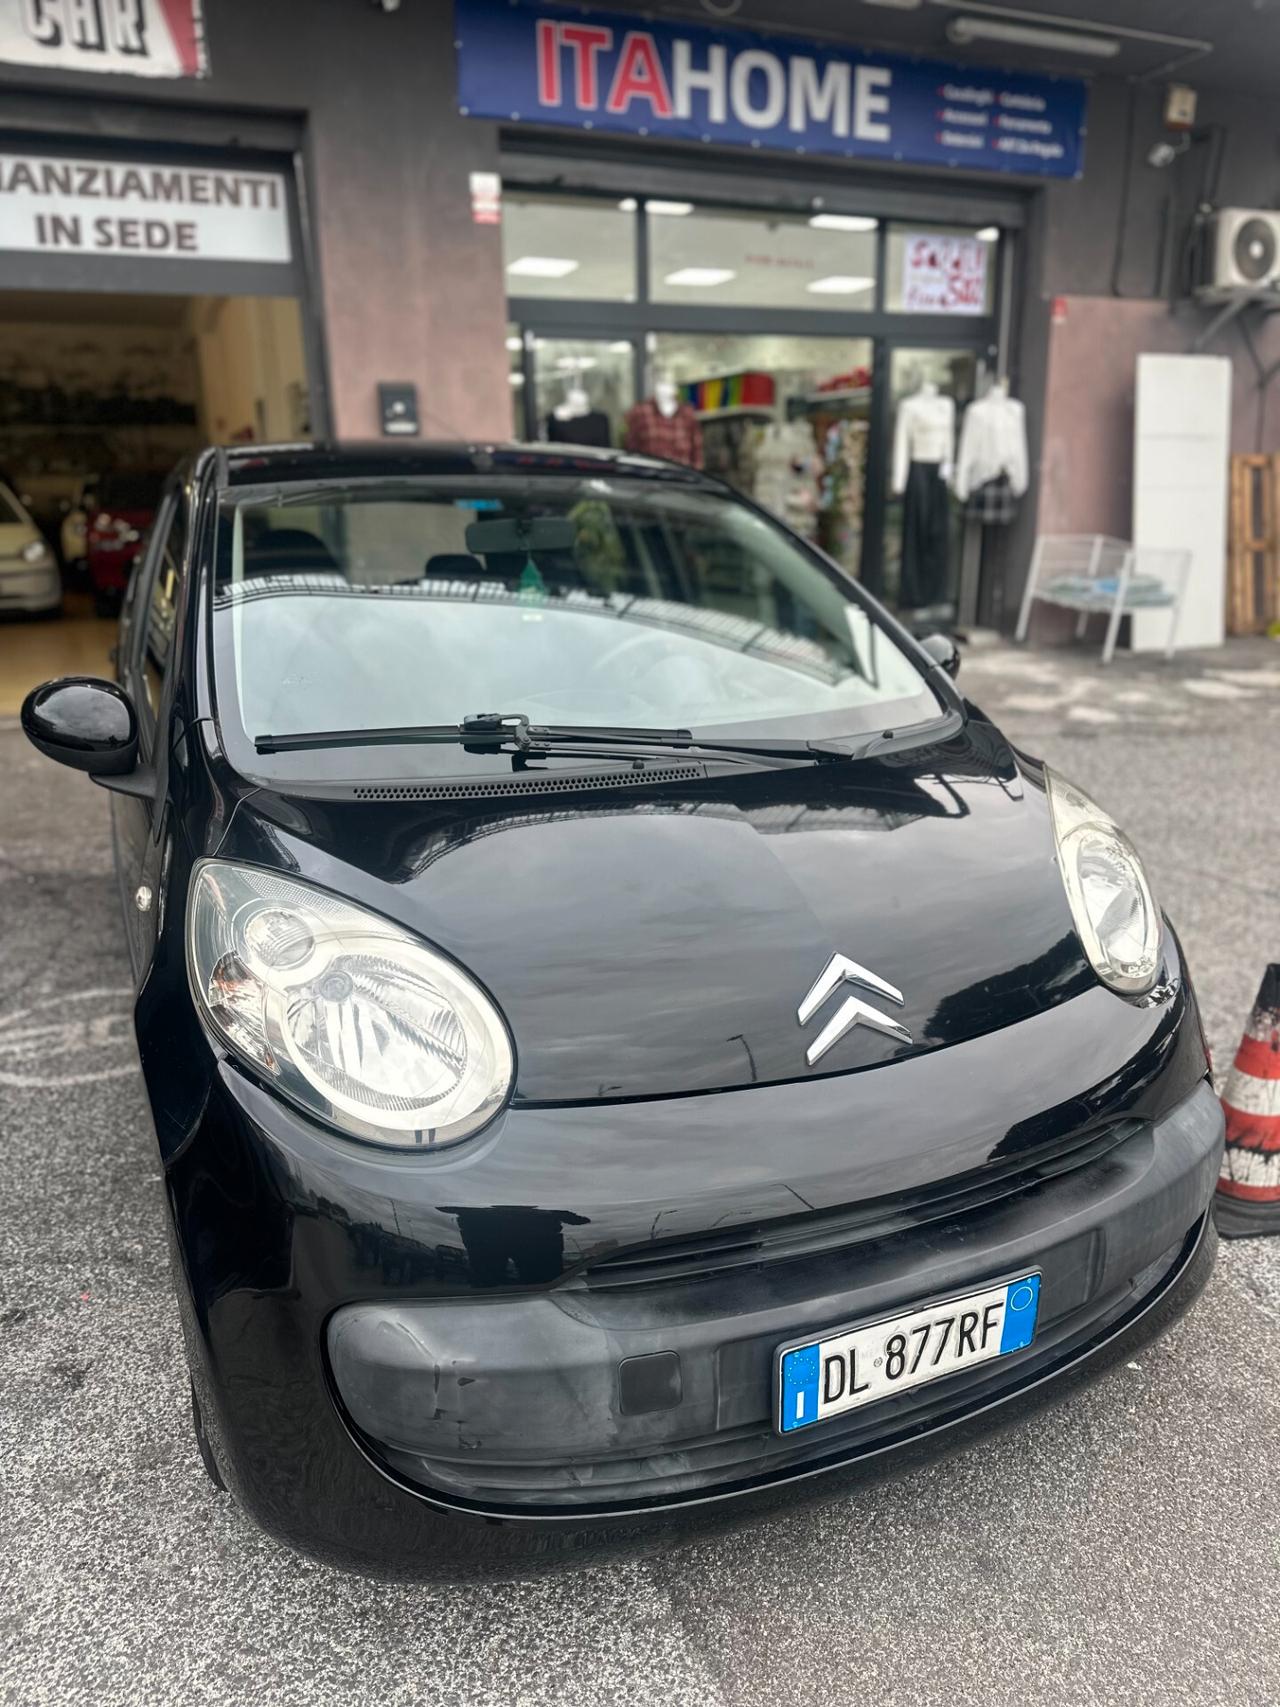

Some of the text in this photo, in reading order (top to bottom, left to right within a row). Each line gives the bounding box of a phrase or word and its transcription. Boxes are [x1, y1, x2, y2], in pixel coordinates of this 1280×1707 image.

[537, 20, 892, 142] ITAHOME
[35, 214, 198, 251] IN SEDE
[823, 1302, 1004, 1405] DL 877RF
